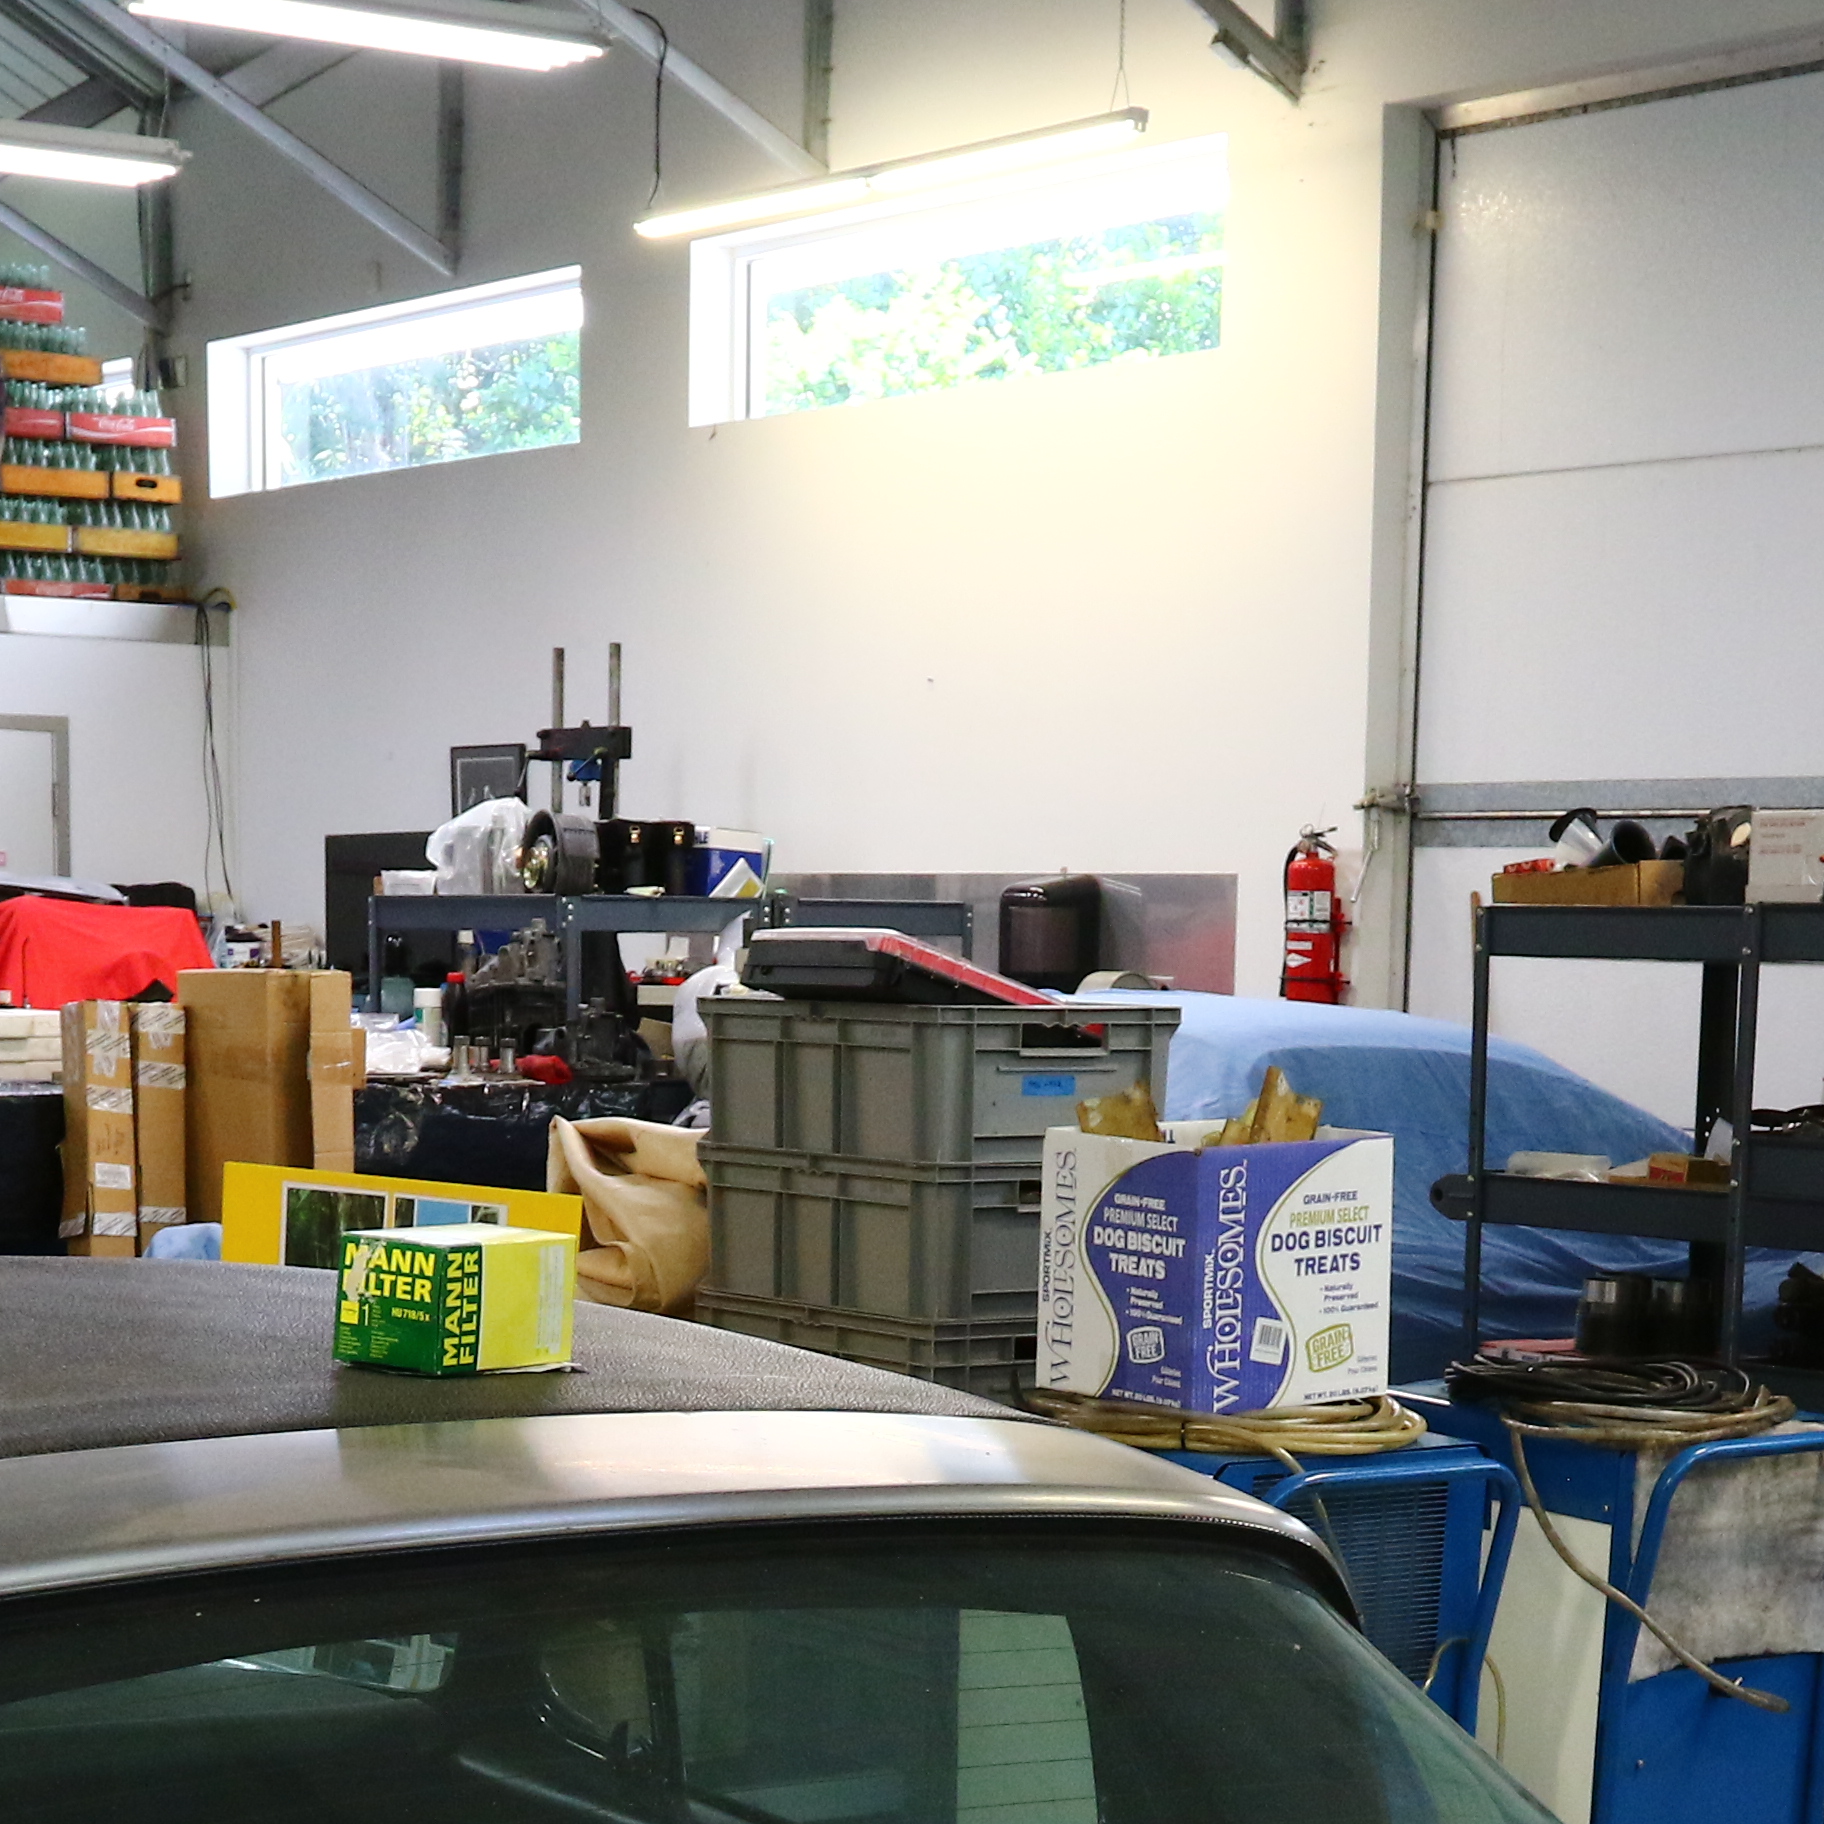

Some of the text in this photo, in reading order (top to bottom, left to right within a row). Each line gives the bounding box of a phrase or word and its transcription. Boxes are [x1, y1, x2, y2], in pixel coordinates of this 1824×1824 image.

[1114, 1193, 1166, 1211] GRAIN-FREE
[1303, 1190, 1358, 1205] GRAIN-FREE
[1103, 1206, 1179, 1232] PREMIUM SELECT
[1290, 1205, 1370, 1228] PREMIUM SELECT
[1093, 1225, 1186, 1258] DOG BISCUIT
[1271, 1224, 1383, 1252] DOG BISCUIT
[1045, 1149, 1077, 1386] WHOLESOMES
[1109, 1252, 1166, 1280] TREATS
[1294, 1251, 1361, 1277] TREATS
[1206, 1163, 1247, 1413] WHOLESOMES
[1324, 1282, 1354, 1292] Naturally
[442, 1252, 463, 1367] MANN
[459, 1251, 480, 1365] FILTER
[1131, 1331, 1159, 1346] GRAIN
[1312, 1328, 1346, 1353] GRAIN
[1136, 1345, 1157, 1360] FREE
[1317, 1344, 1345, 1367] FREE
